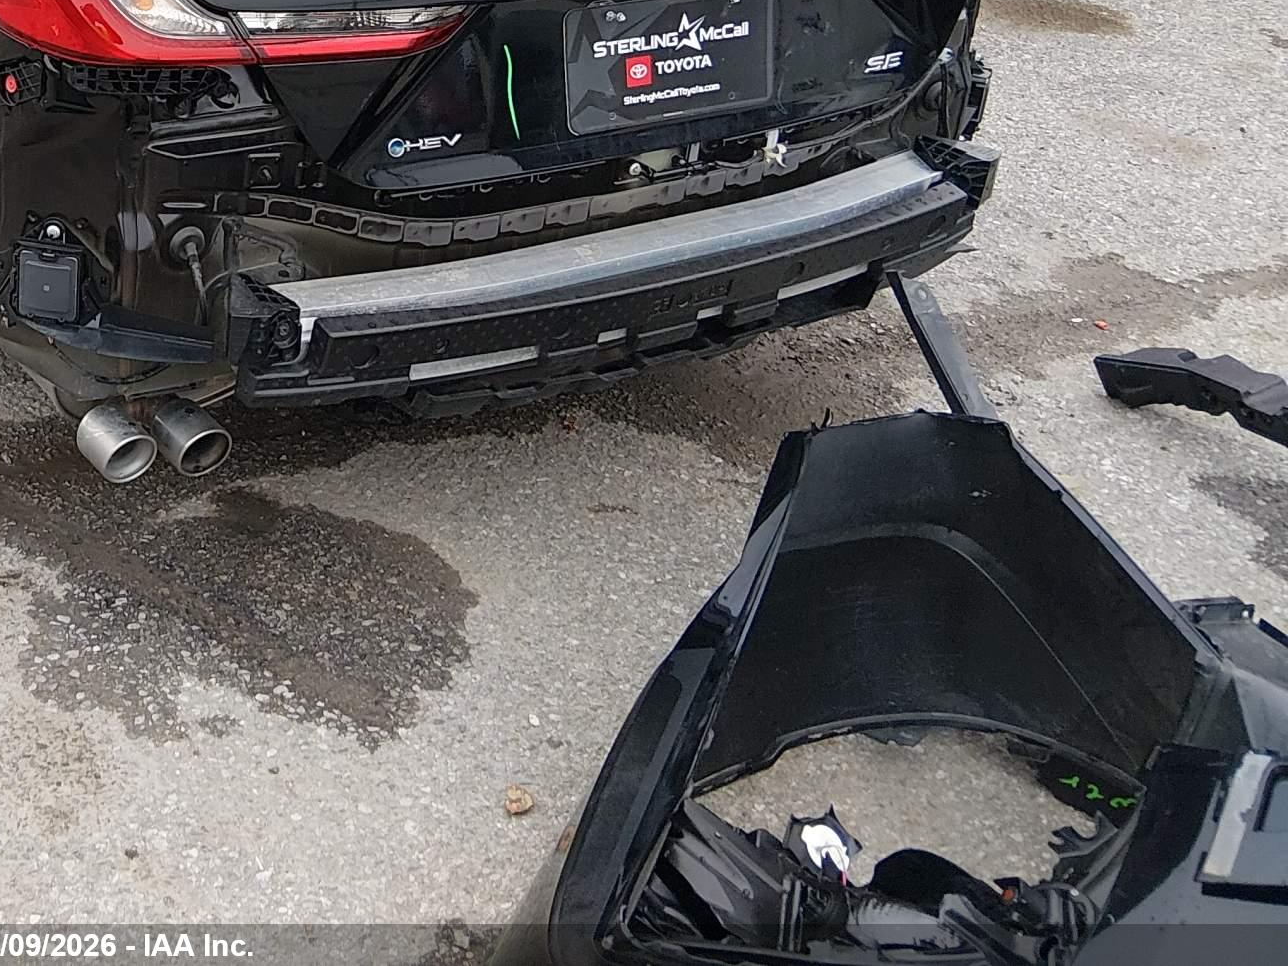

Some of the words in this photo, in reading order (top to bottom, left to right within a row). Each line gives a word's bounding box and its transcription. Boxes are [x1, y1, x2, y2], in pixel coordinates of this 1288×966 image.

[592, 31, 679, 59] STERLING
[698, 21, 750, 42] McCall
[655, 54, 713, 75] TOYOTA
[863, 50, 904, 74] SE
[623, 82, 721, 106] SterlingMcCallToyota.com
